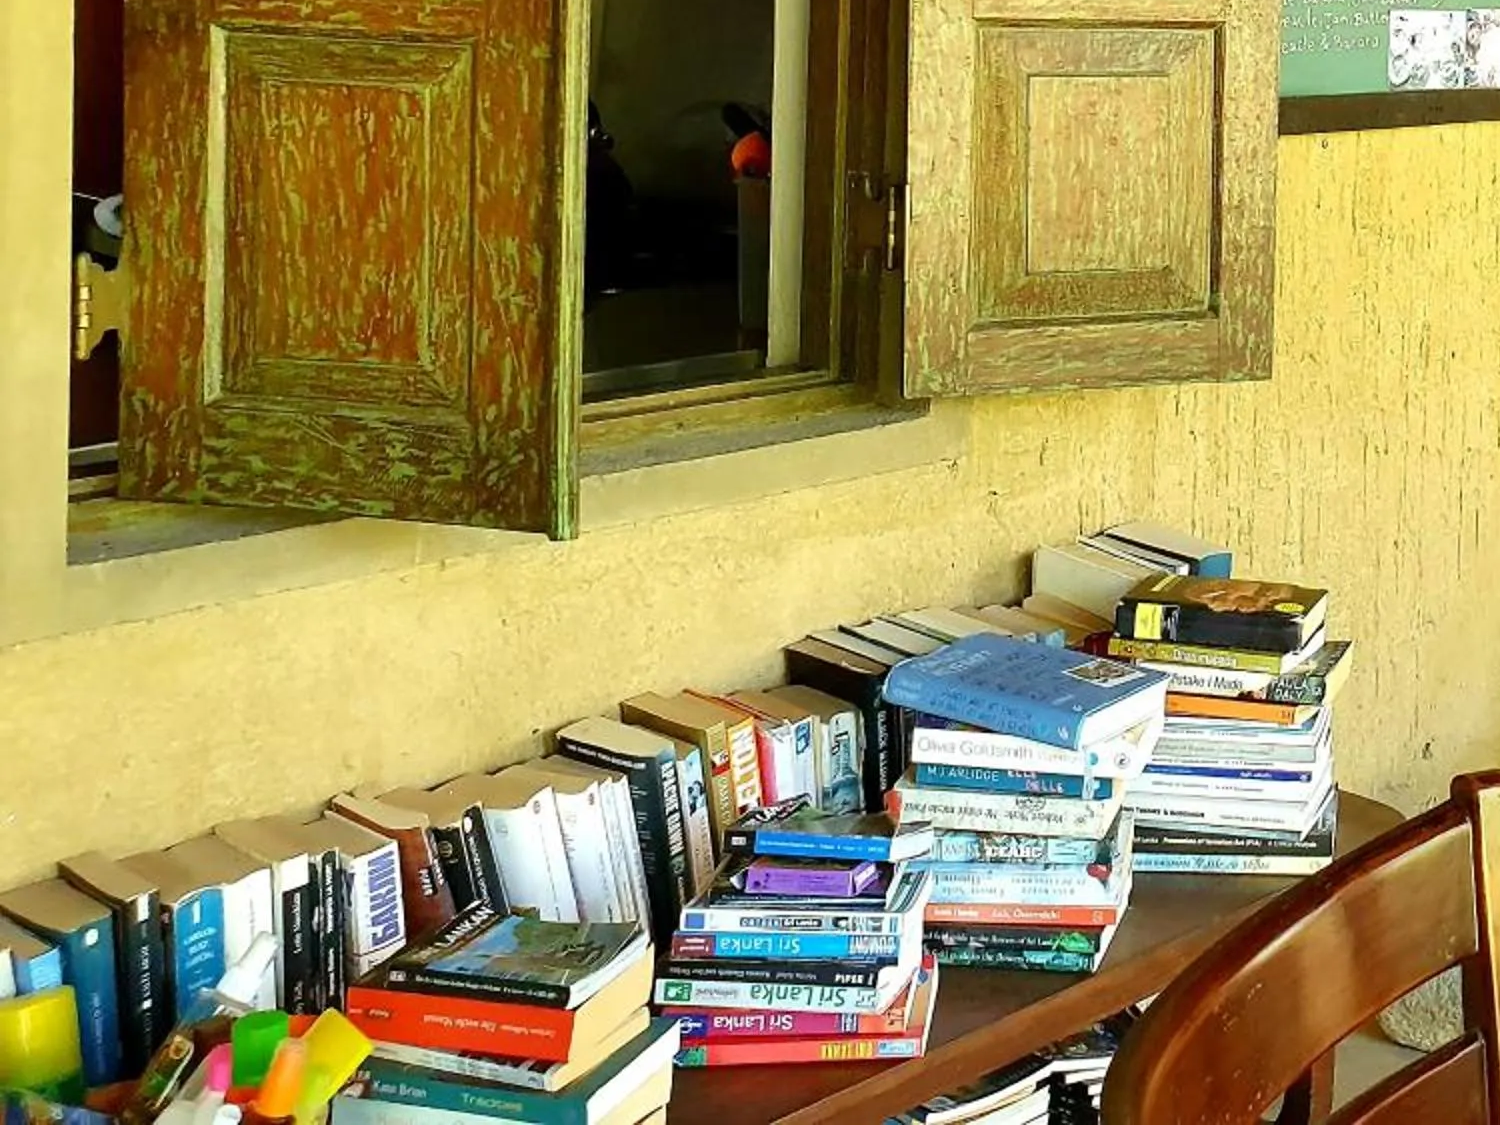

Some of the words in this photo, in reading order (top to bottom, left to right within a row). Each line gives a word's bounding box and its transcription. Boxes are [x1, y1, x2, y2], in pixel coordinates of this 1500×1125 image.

[959, 738, 1034, 762] Goldsmith
[660, 761, 679, 816] APACHE
[664, 815, 686, 857] DAWN
[367, 850, 402, 948] БАКЛИ
[720, 937, 773, 956] Lanka
[779, 937, 800, 956] Sri
[750, 983, 815, 1007] Lanka
[818, 987, 846, 1008] Sri
[713, 1014, 765, 1031] Lanka
[769, 1013, 793, 1031] Sri
